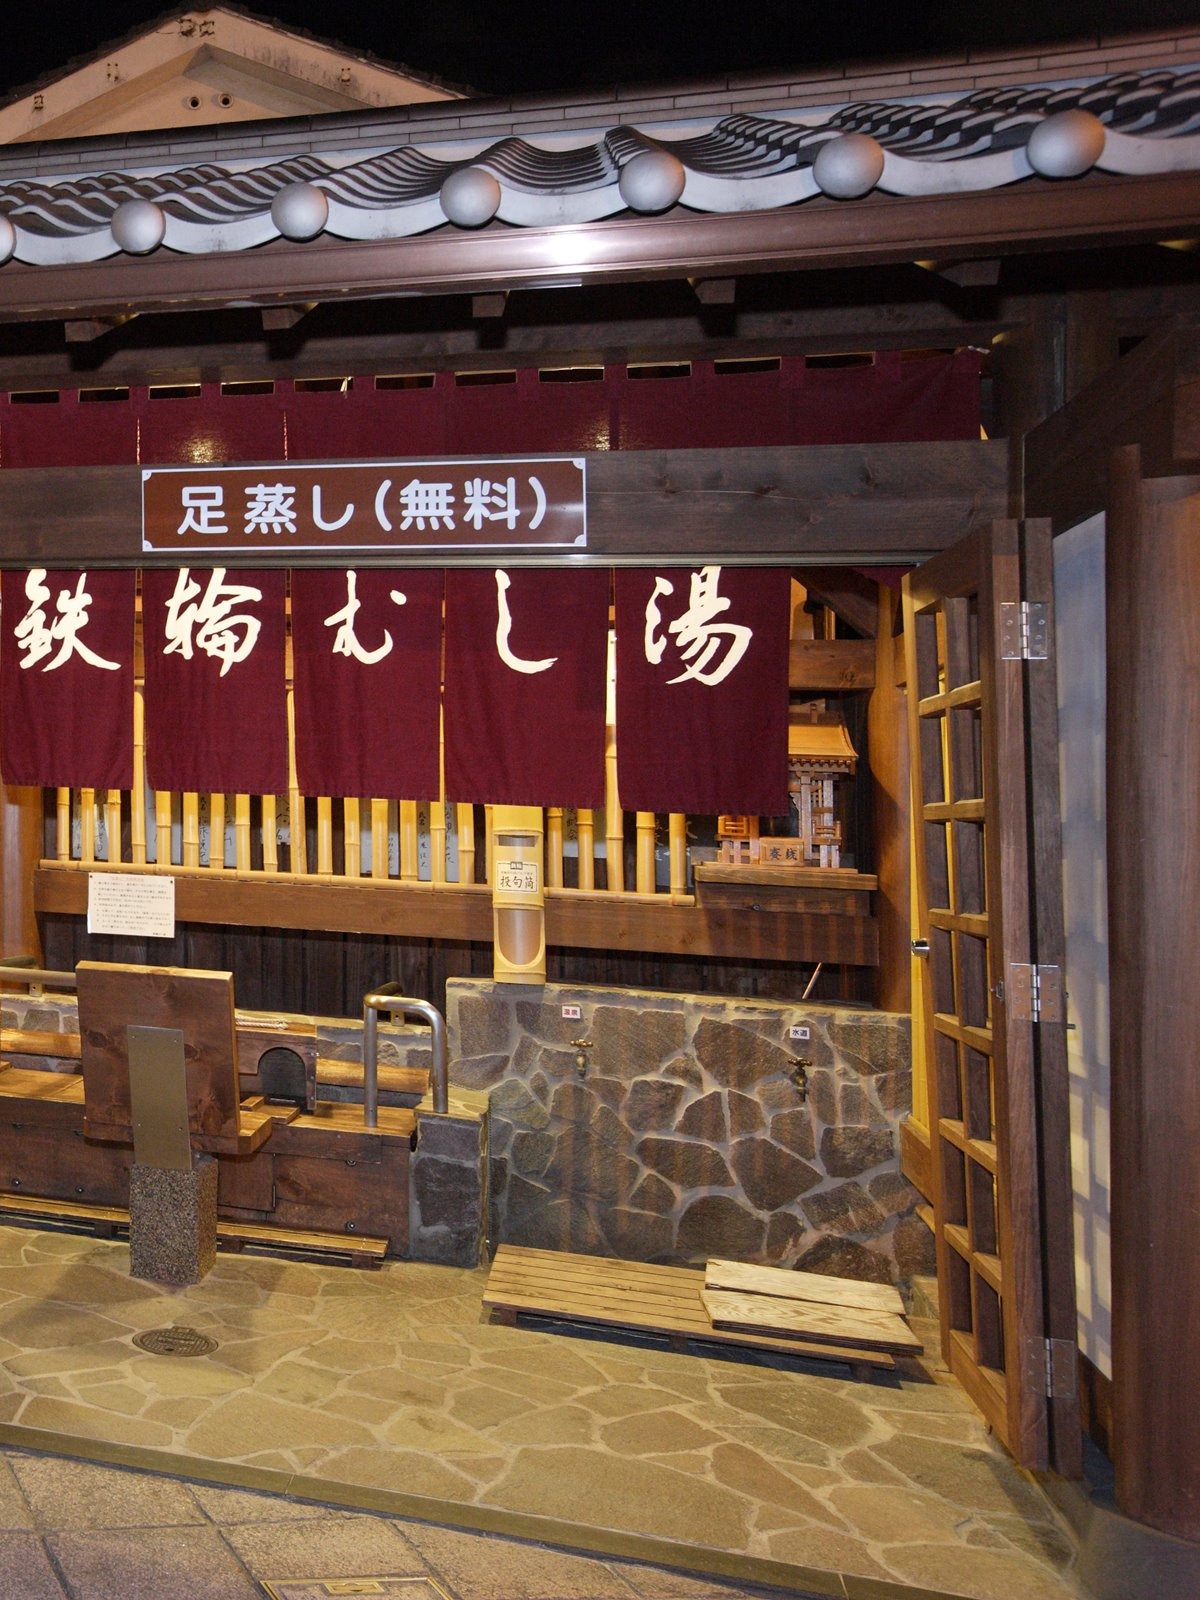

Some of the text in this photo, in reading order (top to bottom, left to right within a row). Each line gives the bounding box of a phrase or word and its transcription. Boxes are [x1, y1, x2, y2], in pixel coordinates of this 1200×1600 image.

[177, 477, 547, 535] 足蒸し(無料)
